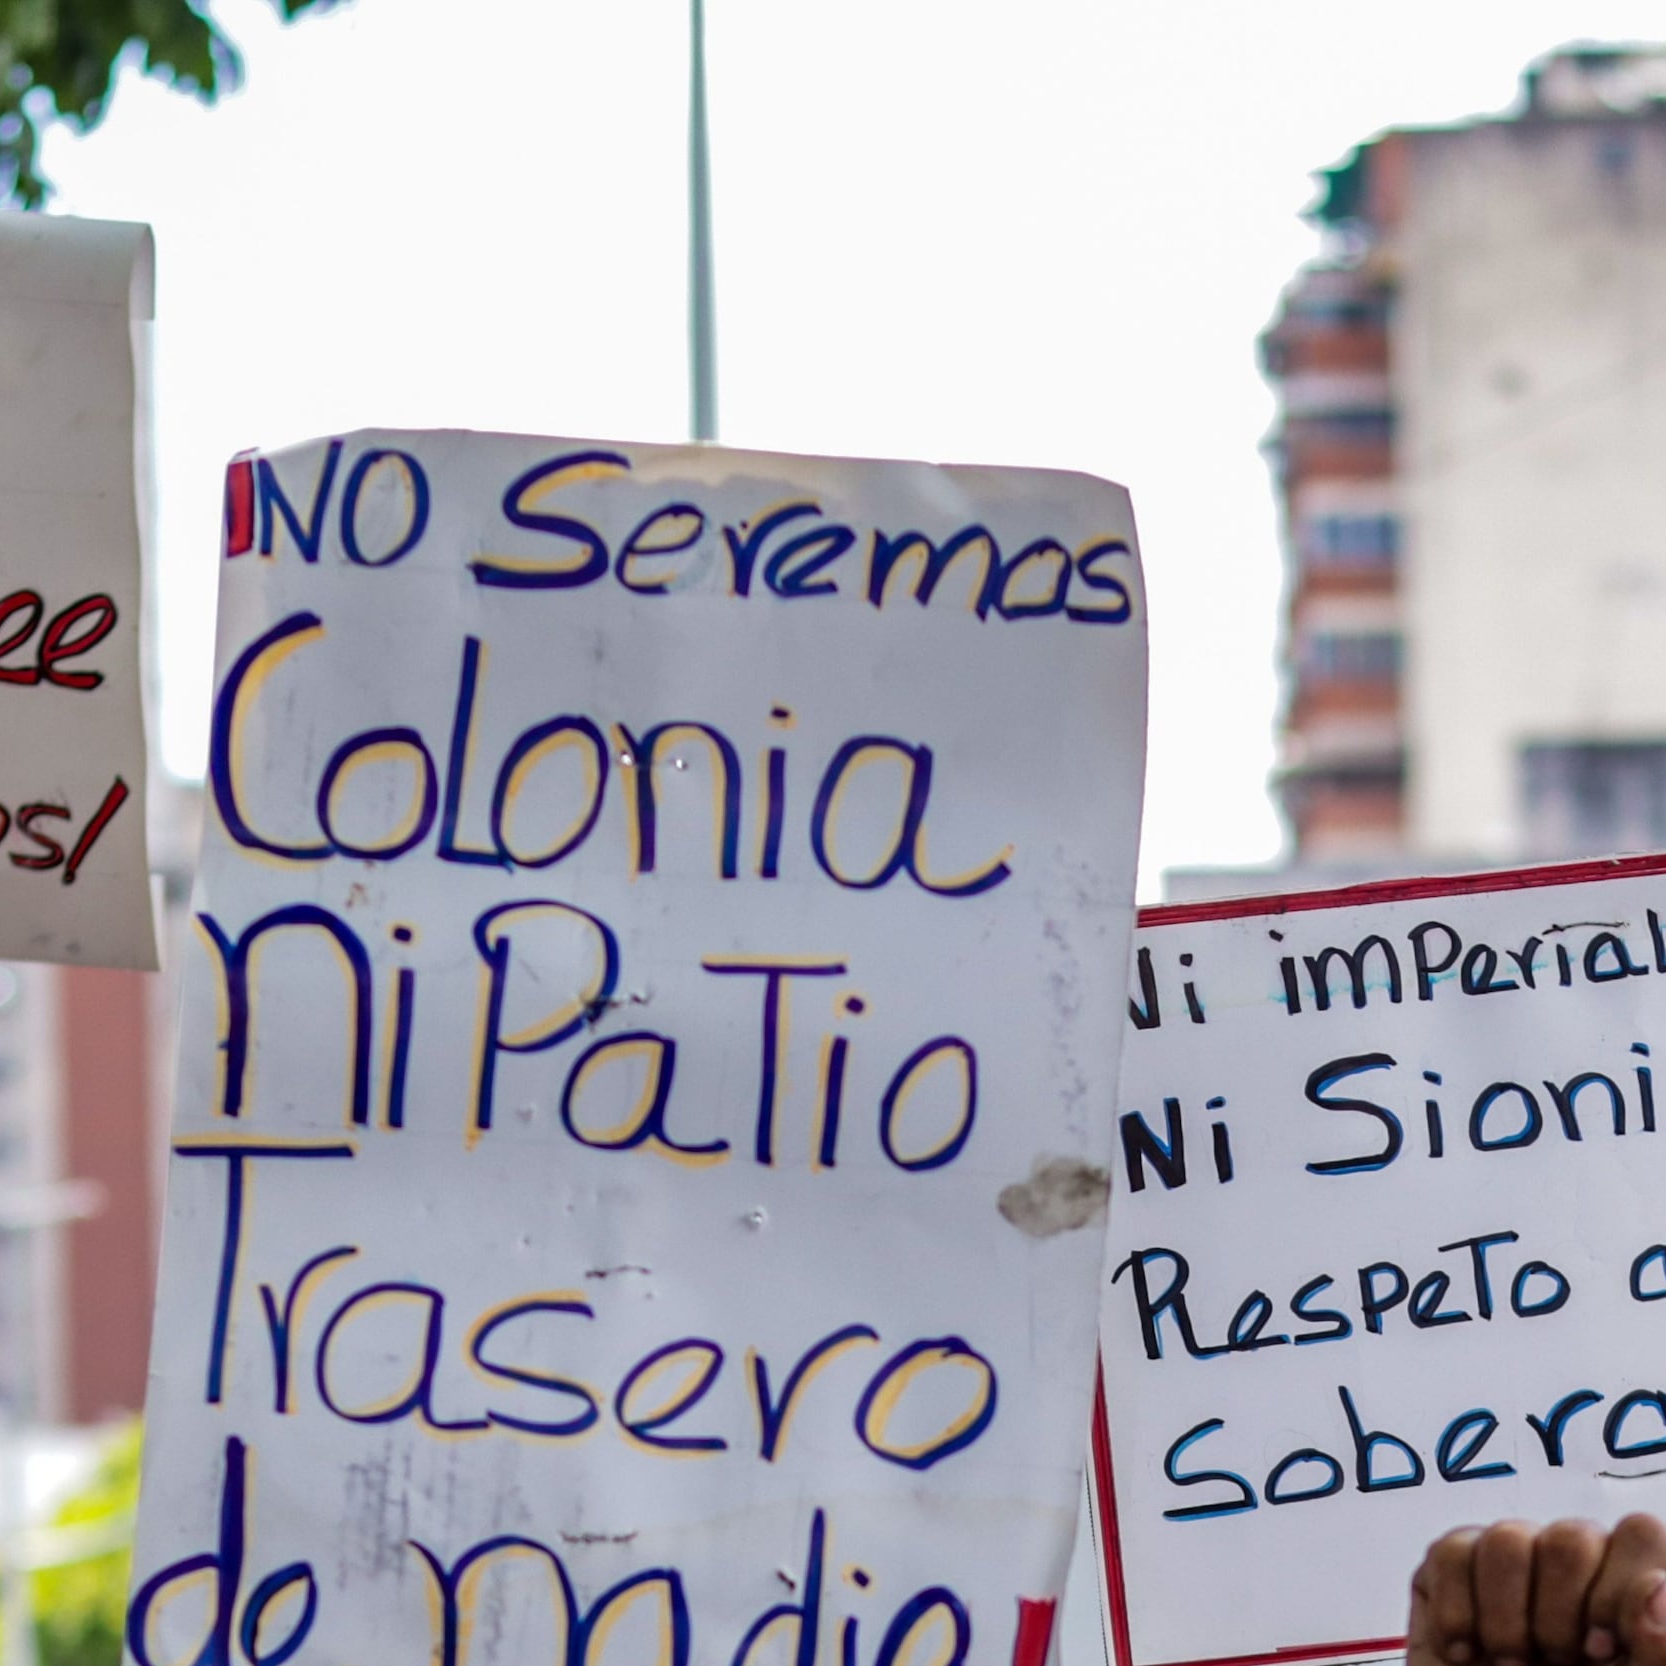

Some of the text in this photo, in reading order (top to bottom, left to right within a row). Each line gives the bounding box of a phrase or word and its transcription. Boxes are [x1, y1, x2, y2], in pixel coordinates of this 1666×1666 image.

[469, 451, 1130, 622] Seremos
[1120, 1096, 1233, 1191] Ni
[173, 1137, 997, 1470] Trasero
